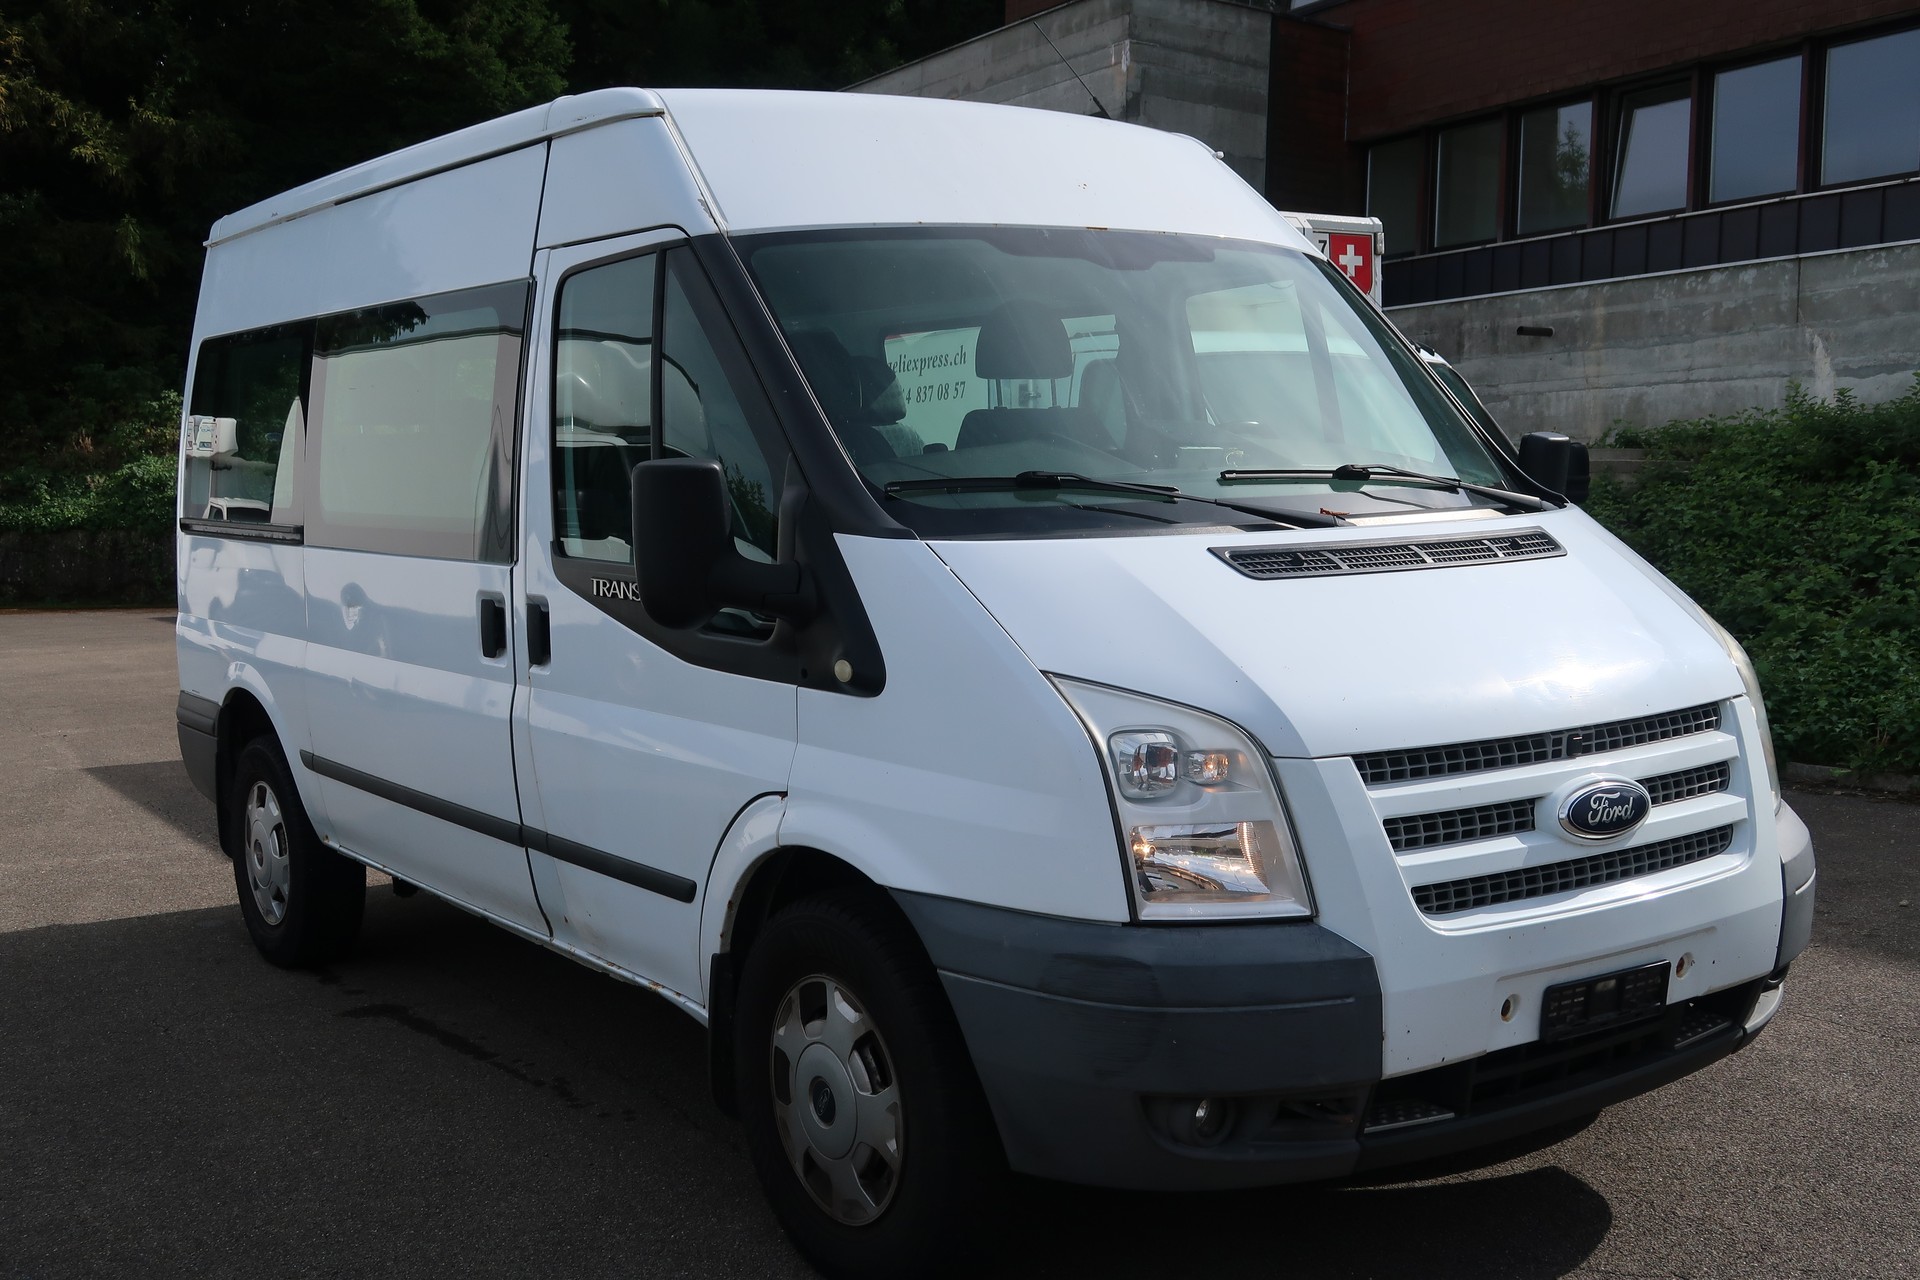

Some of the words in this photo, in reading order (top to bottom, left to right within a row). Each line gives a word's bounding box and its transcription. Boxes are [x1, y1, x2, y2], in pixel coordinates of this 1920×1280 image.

[916, 385, 934, 403] 837
[937, 383, 950, 401] 08
[953, 381, 966, 399] 57
[1588, 792, 1635, 826] Ford
